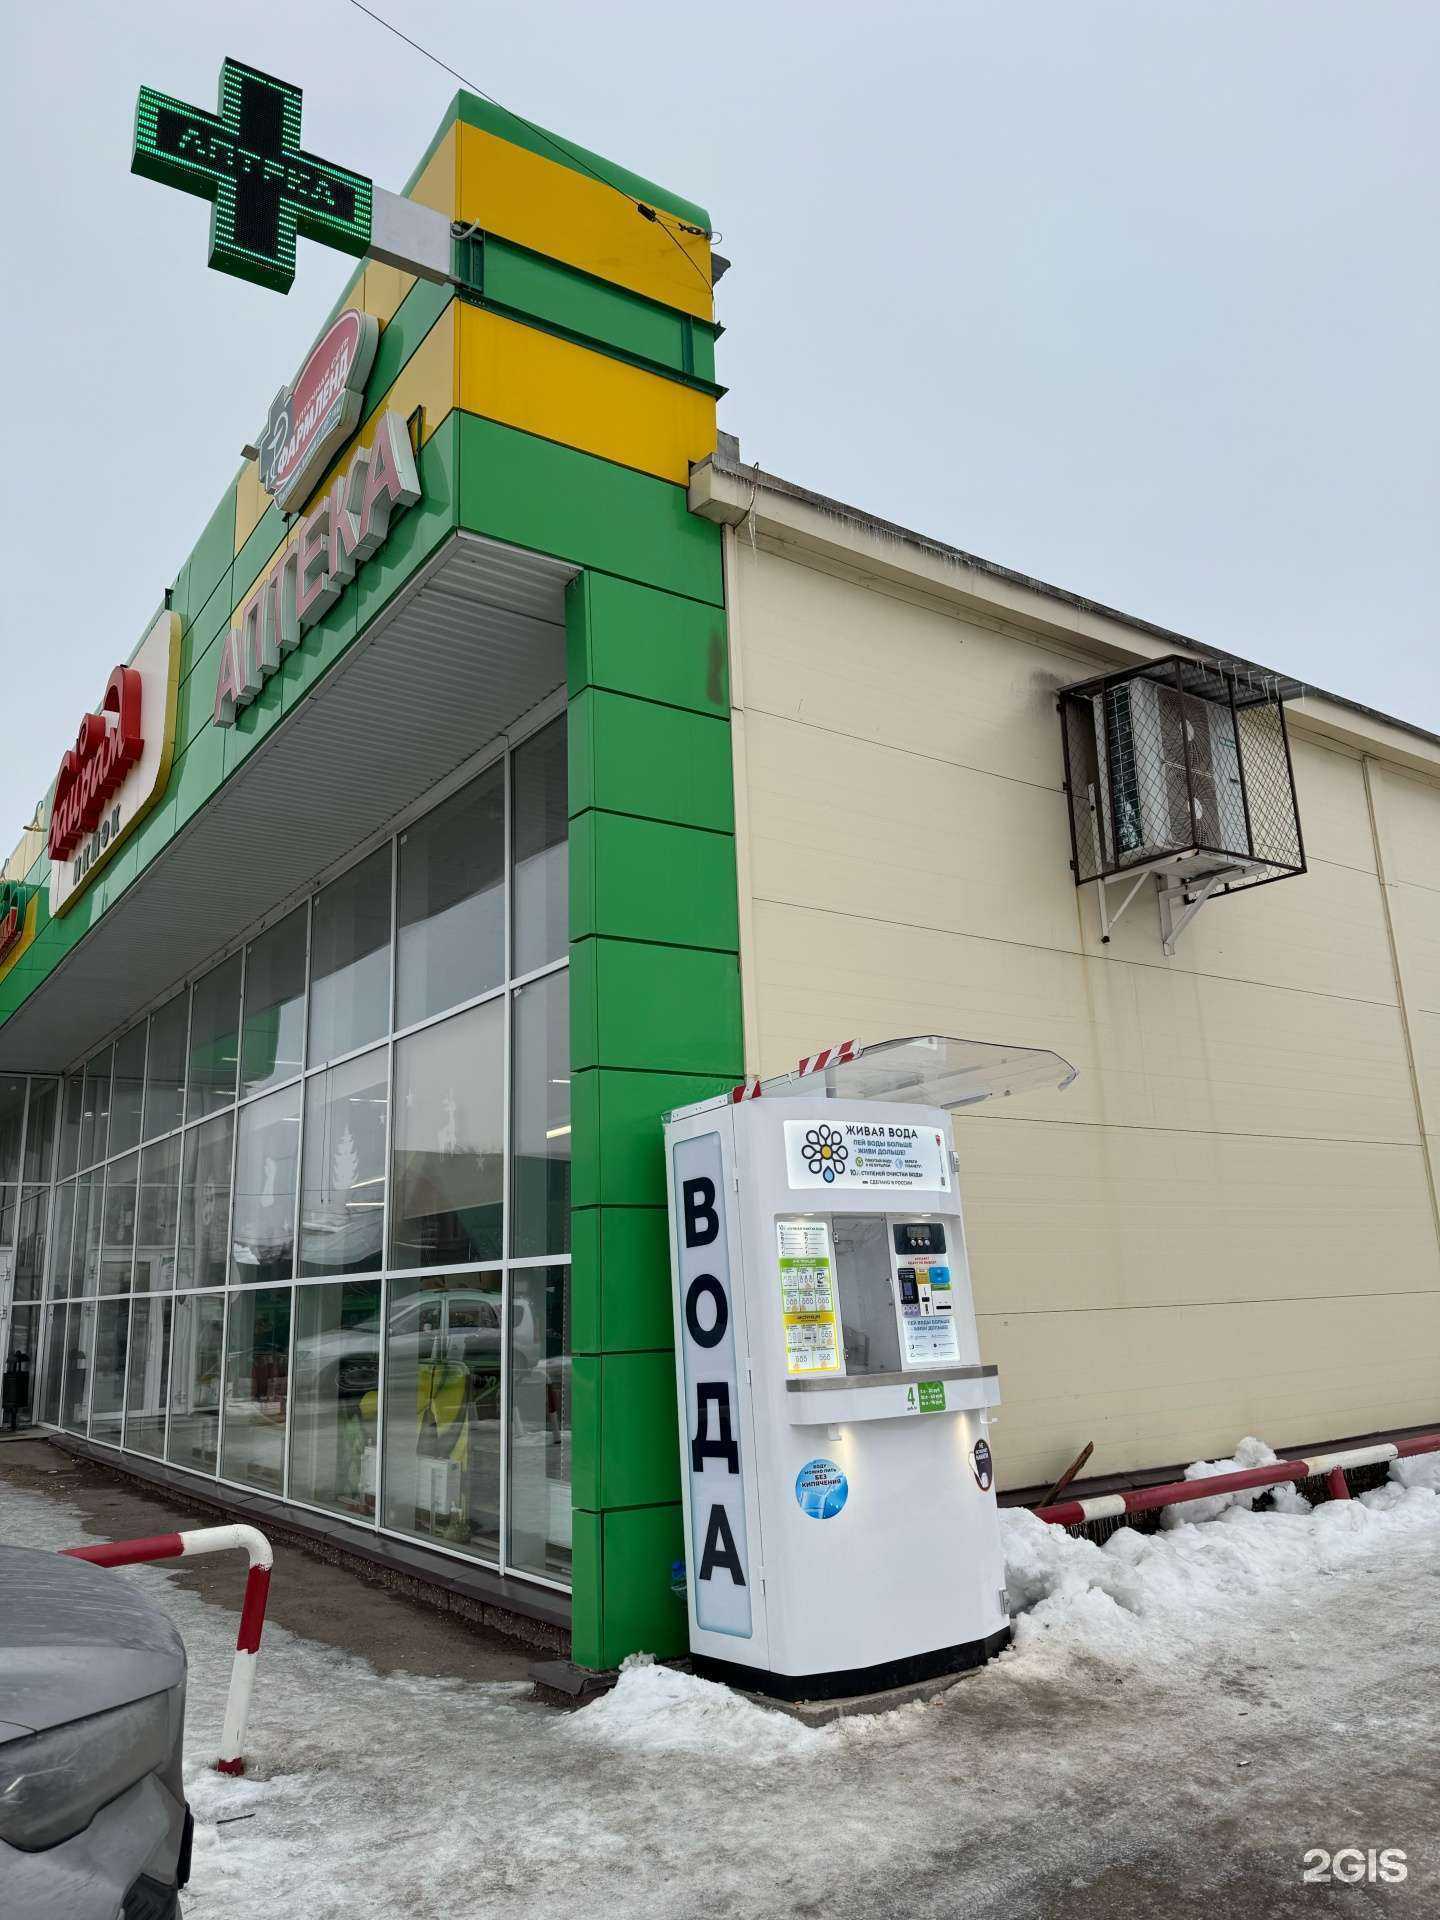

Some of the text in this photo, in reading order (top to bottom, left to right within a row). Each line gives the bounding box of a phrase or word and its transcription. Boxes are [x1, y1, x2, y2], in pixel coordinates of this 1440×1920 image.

[277, 347, 350, 475] ФАРМЛЕНД
[213, 407, 421, 729] АПТЕКА
[846, 1125, 918, 1140] ЖИВАЯ ВОДА
[682, 1176, 747, 1587] ВОДА
[907, 1386, 916, 1405] 4
[801, 1478, 841, 1488] КИПЯЧЕНИЯ
